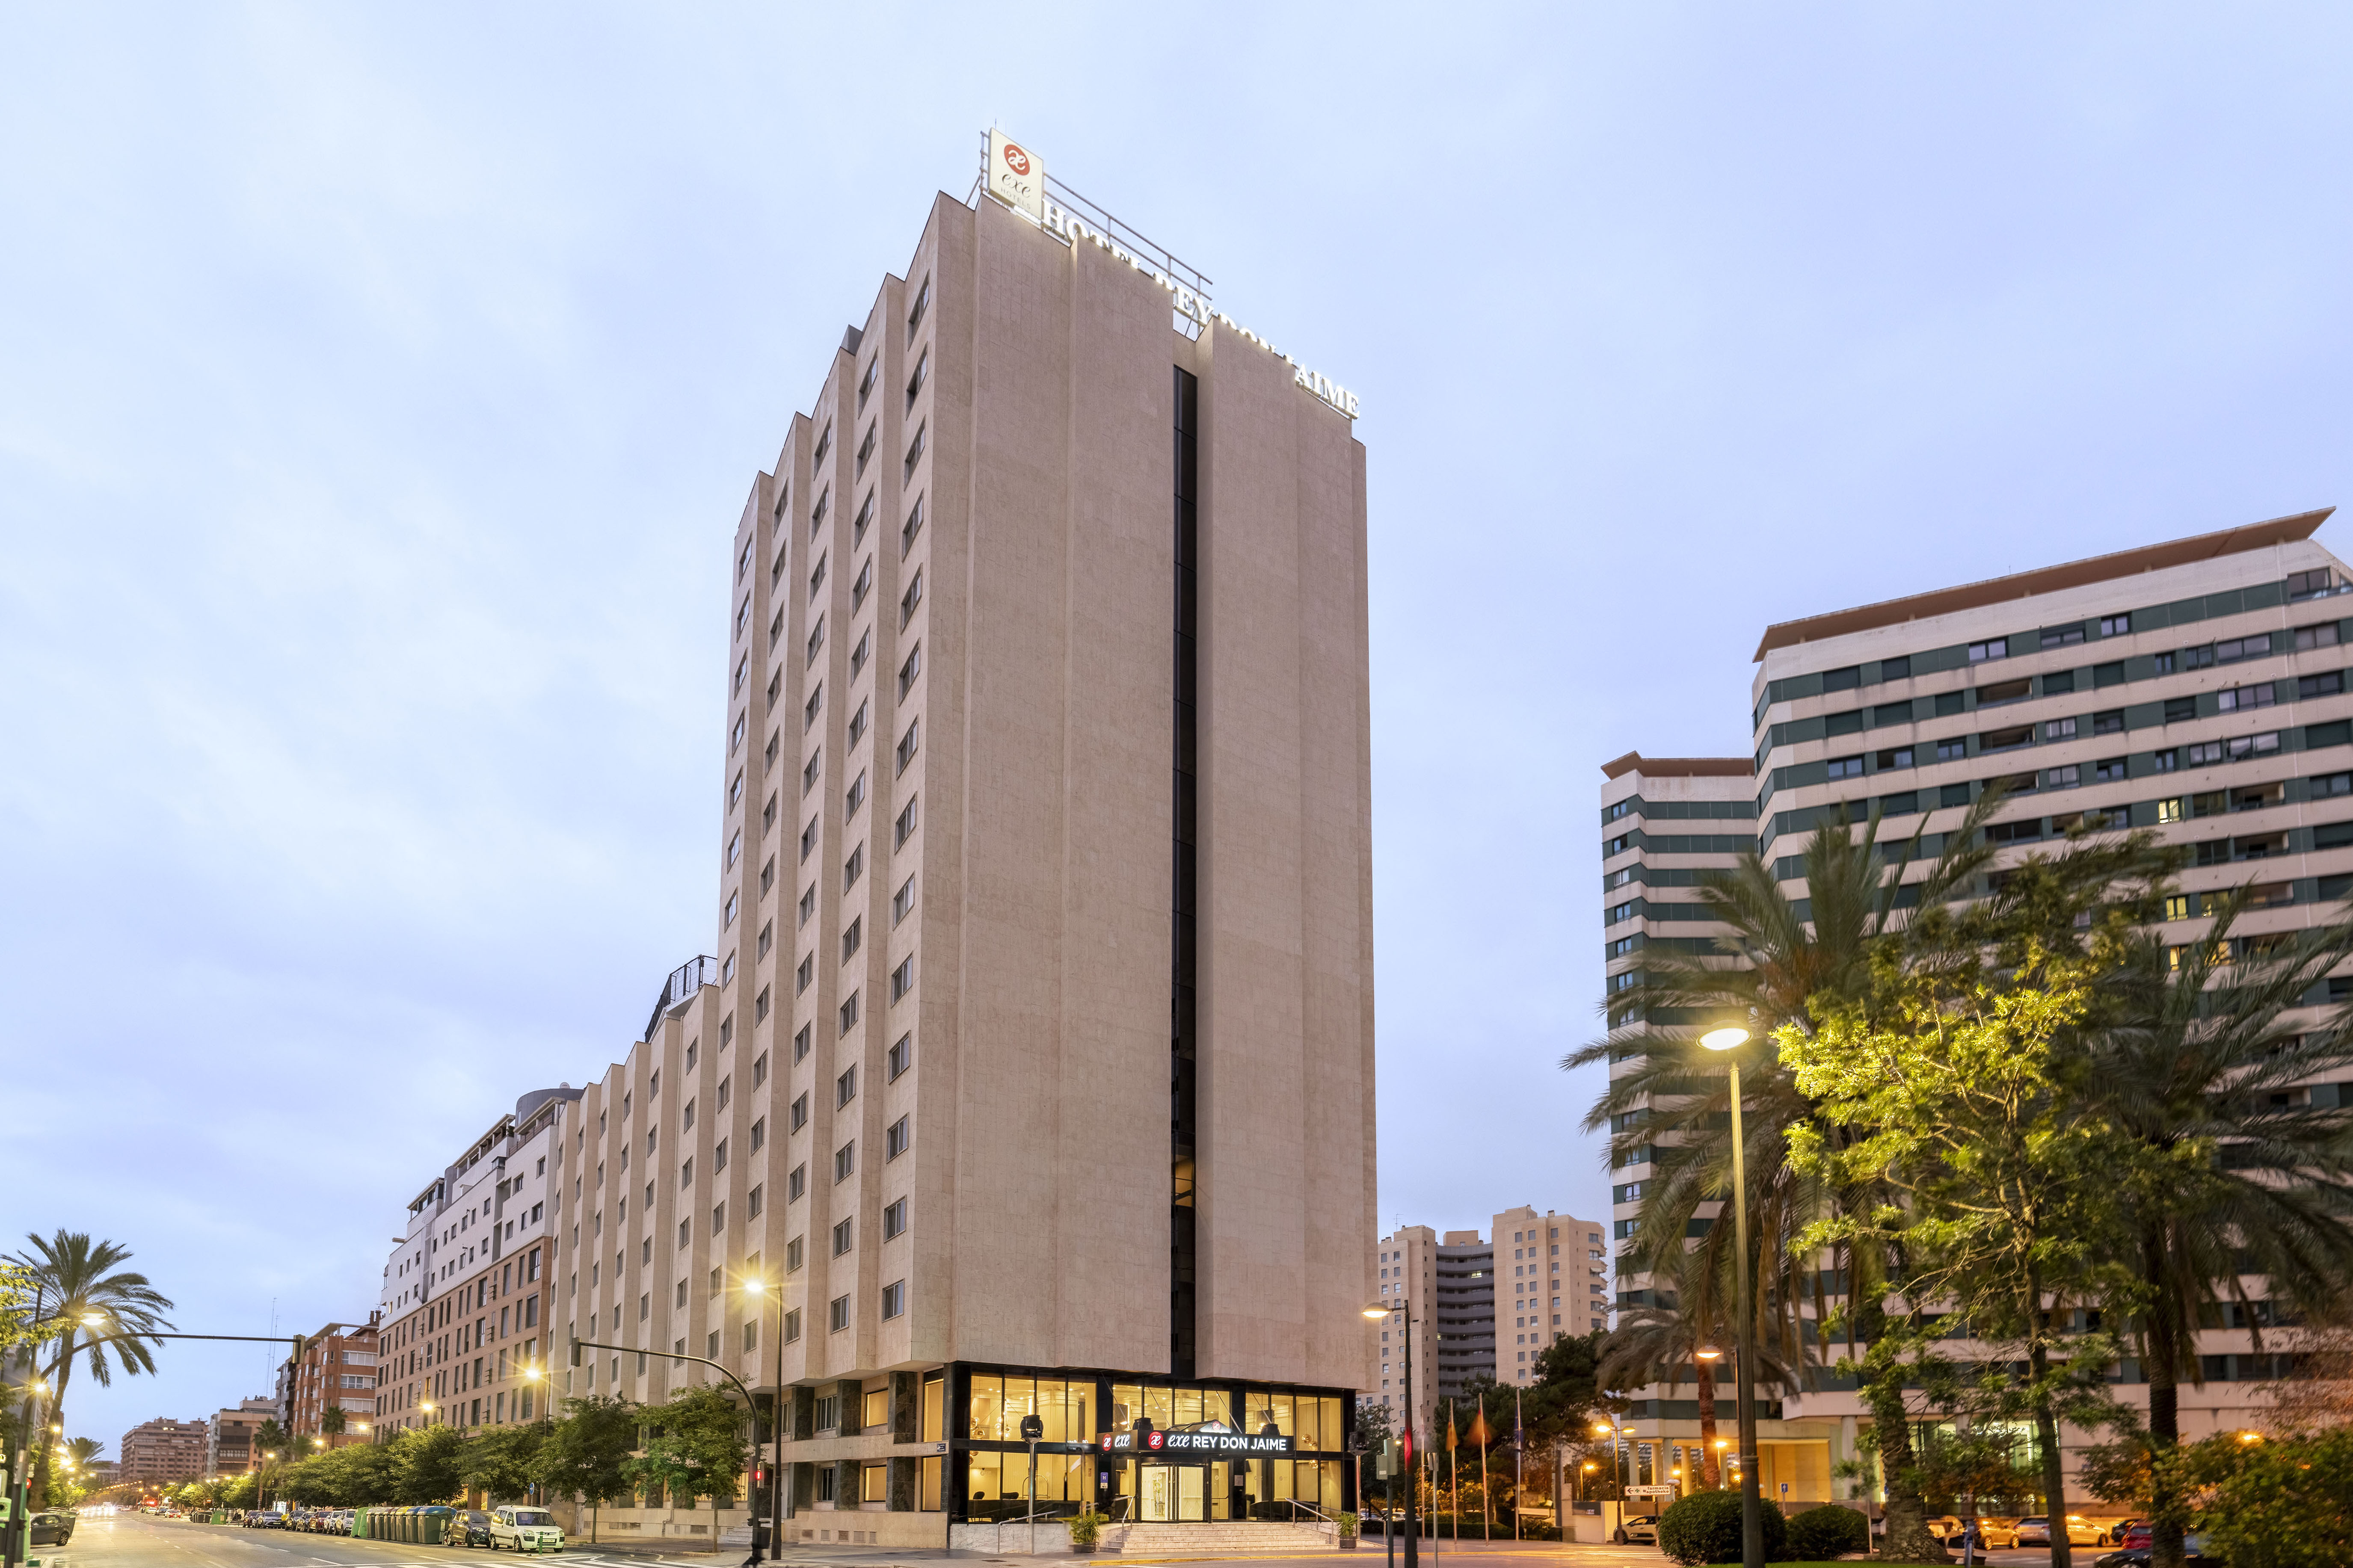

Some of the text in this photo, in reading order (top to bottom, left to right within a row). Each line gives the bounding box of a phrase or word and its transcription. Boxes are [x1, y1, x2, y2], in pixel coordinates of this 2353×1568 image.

[1002, 174, 1031, 198] exe
[1001, 187, 1031, 210] HOTELS
[1114, 1435, 1130, 1447] exe
[1168, 1435, 1190, 1447] exe
[1193, 1436, 1218, 1448] REY
[1221, 1437, 1248, 1450] DON
[1251, 1438, 1286, 1451] JAIME
